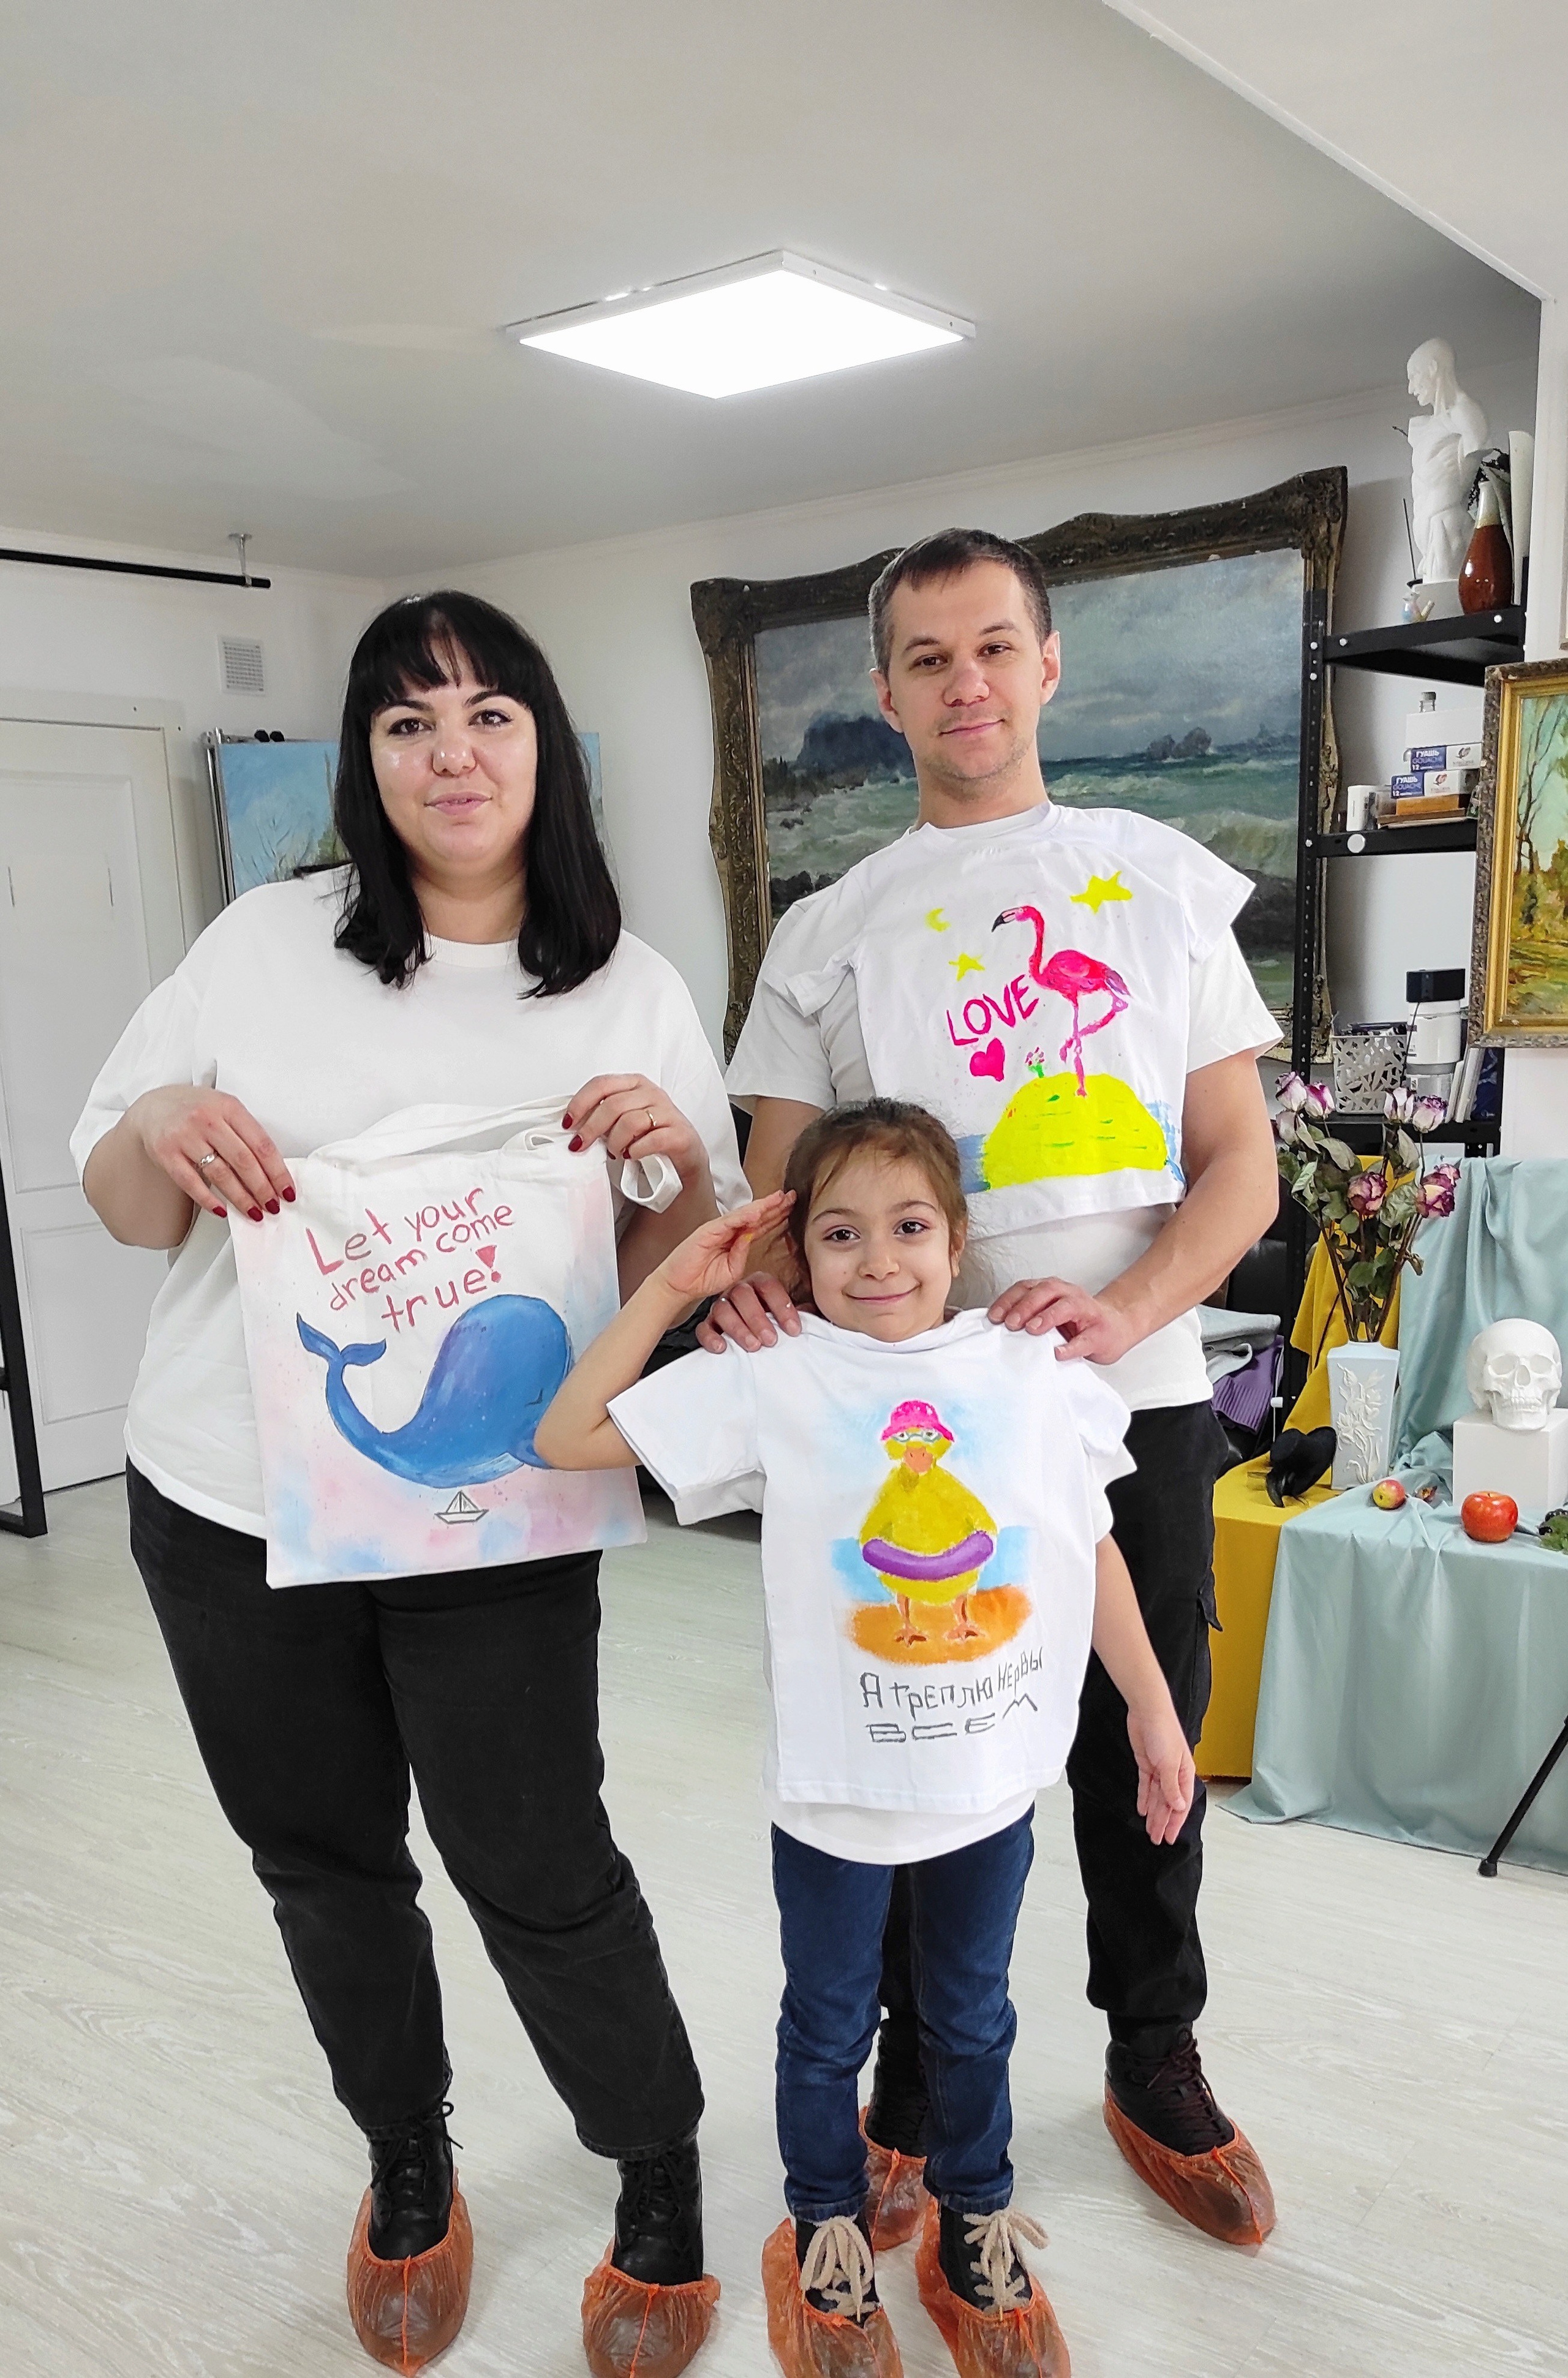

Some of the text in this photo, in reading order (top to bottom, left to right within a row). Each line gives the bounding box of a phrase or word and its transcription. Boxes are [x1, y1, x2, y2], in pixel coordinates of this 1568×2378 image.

[1396, 776, 1418, 785] ГУАШЬ
[946, 974, 1039, 1046] LOVE
[306, 1187, 484, 1275] Let your
[330, 1204, 515, 1310] dream come
[381, 1245, 502, 1332] true!
[859, 1672, 883, 1708] Я
